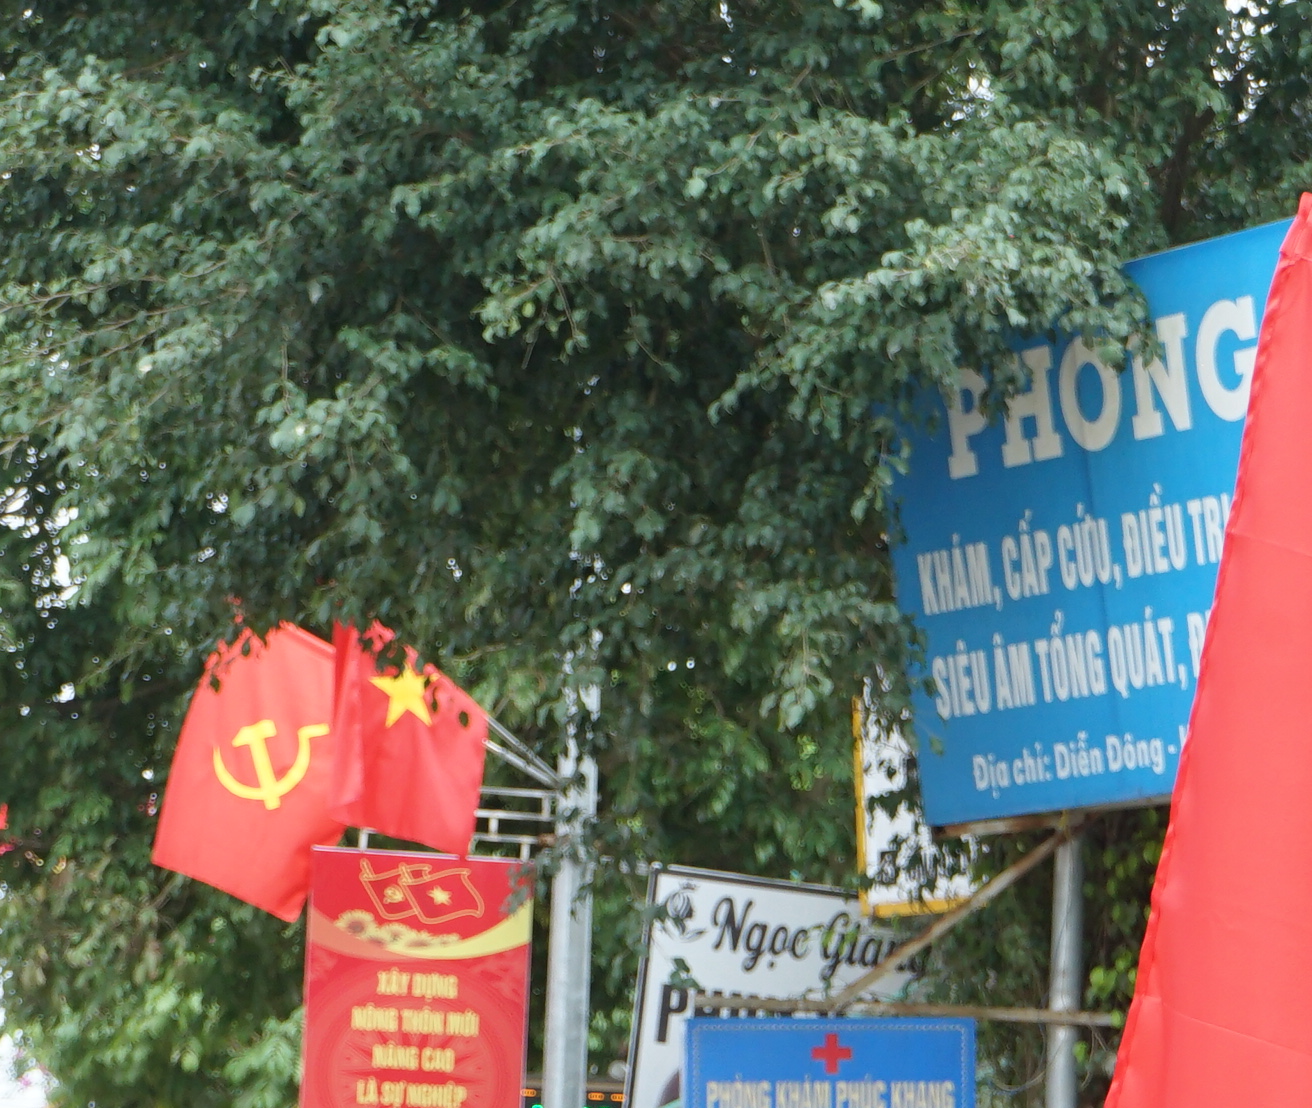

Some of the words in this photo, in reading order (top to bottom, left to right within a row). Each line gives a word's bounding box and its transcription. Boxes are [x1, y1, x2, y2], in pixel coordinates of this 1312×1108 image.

[917, 532, 1004, 616] KHÁM,
[1001, 508, 1053, 601] CẤP
[1056, 502, 1123, 591] CỨU,
[1120, 482, 1188, 578] ĐIỀU
[932, 638, 992, 721] SIÊU
[992, 631, 1036, 711] ÂM
[1034, 608, 1108, 703] TỔNG
[1107, 605, 1188, 700] QUÁT,
[972, 752, 1012, 800] Địa
[1053, 730, 1106, 781] Diễn
[712, 896, 809, 972] Ngọc
[376, 966, 411, 997] XÂY
[350, 1002, 399, 1033] NÔNG
[371, 1040, 420, 1071] NÂNG
[420, 1046, 456, 1073] CAO
[356, 1075, 380, 1106] LÀ
